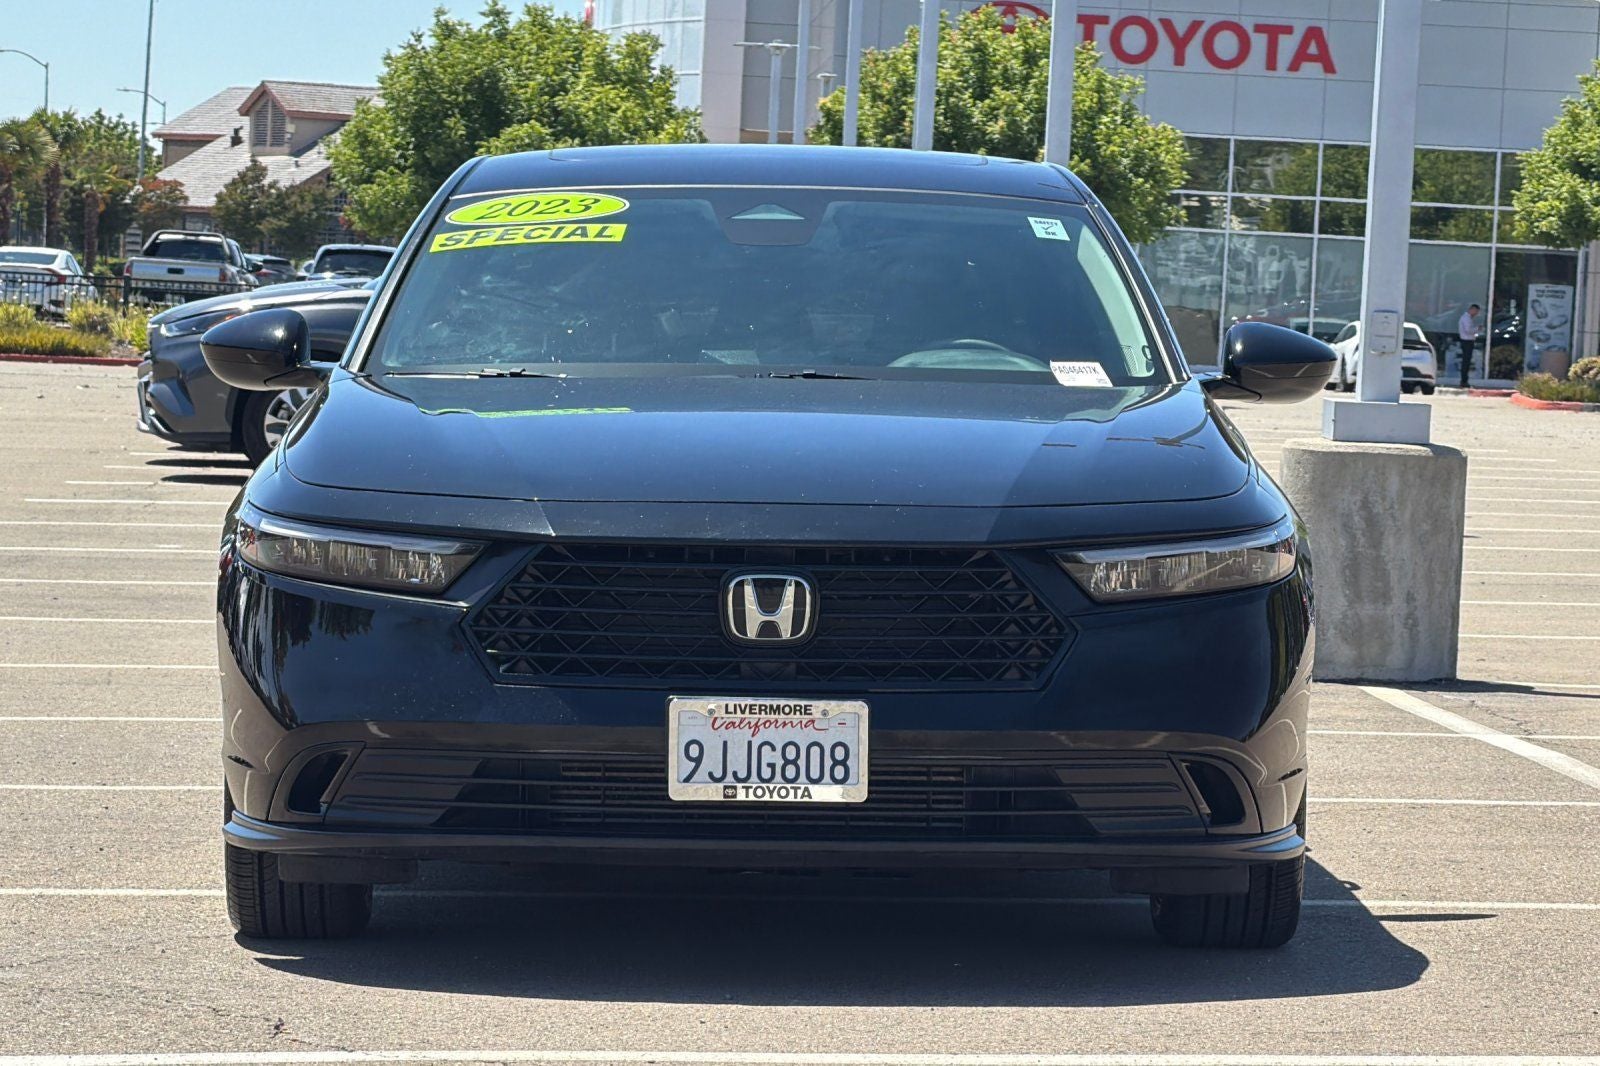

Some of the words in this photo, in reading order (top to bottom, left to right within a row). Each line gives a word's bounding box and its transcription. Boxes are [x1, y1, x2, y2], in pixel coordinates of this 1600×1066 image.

[1077, 13, 1337, 75] TOYOTA
[473, 197, 600, 221] 2023
[438, 225, 615, 248] SPECIAL
[724, 703, 813, 716] LIVERMORE
[711, 716, 829, 737] California
[682, 738, 850, 785] 9JJG808
[741, 785, 813, 800] TOYOTA
